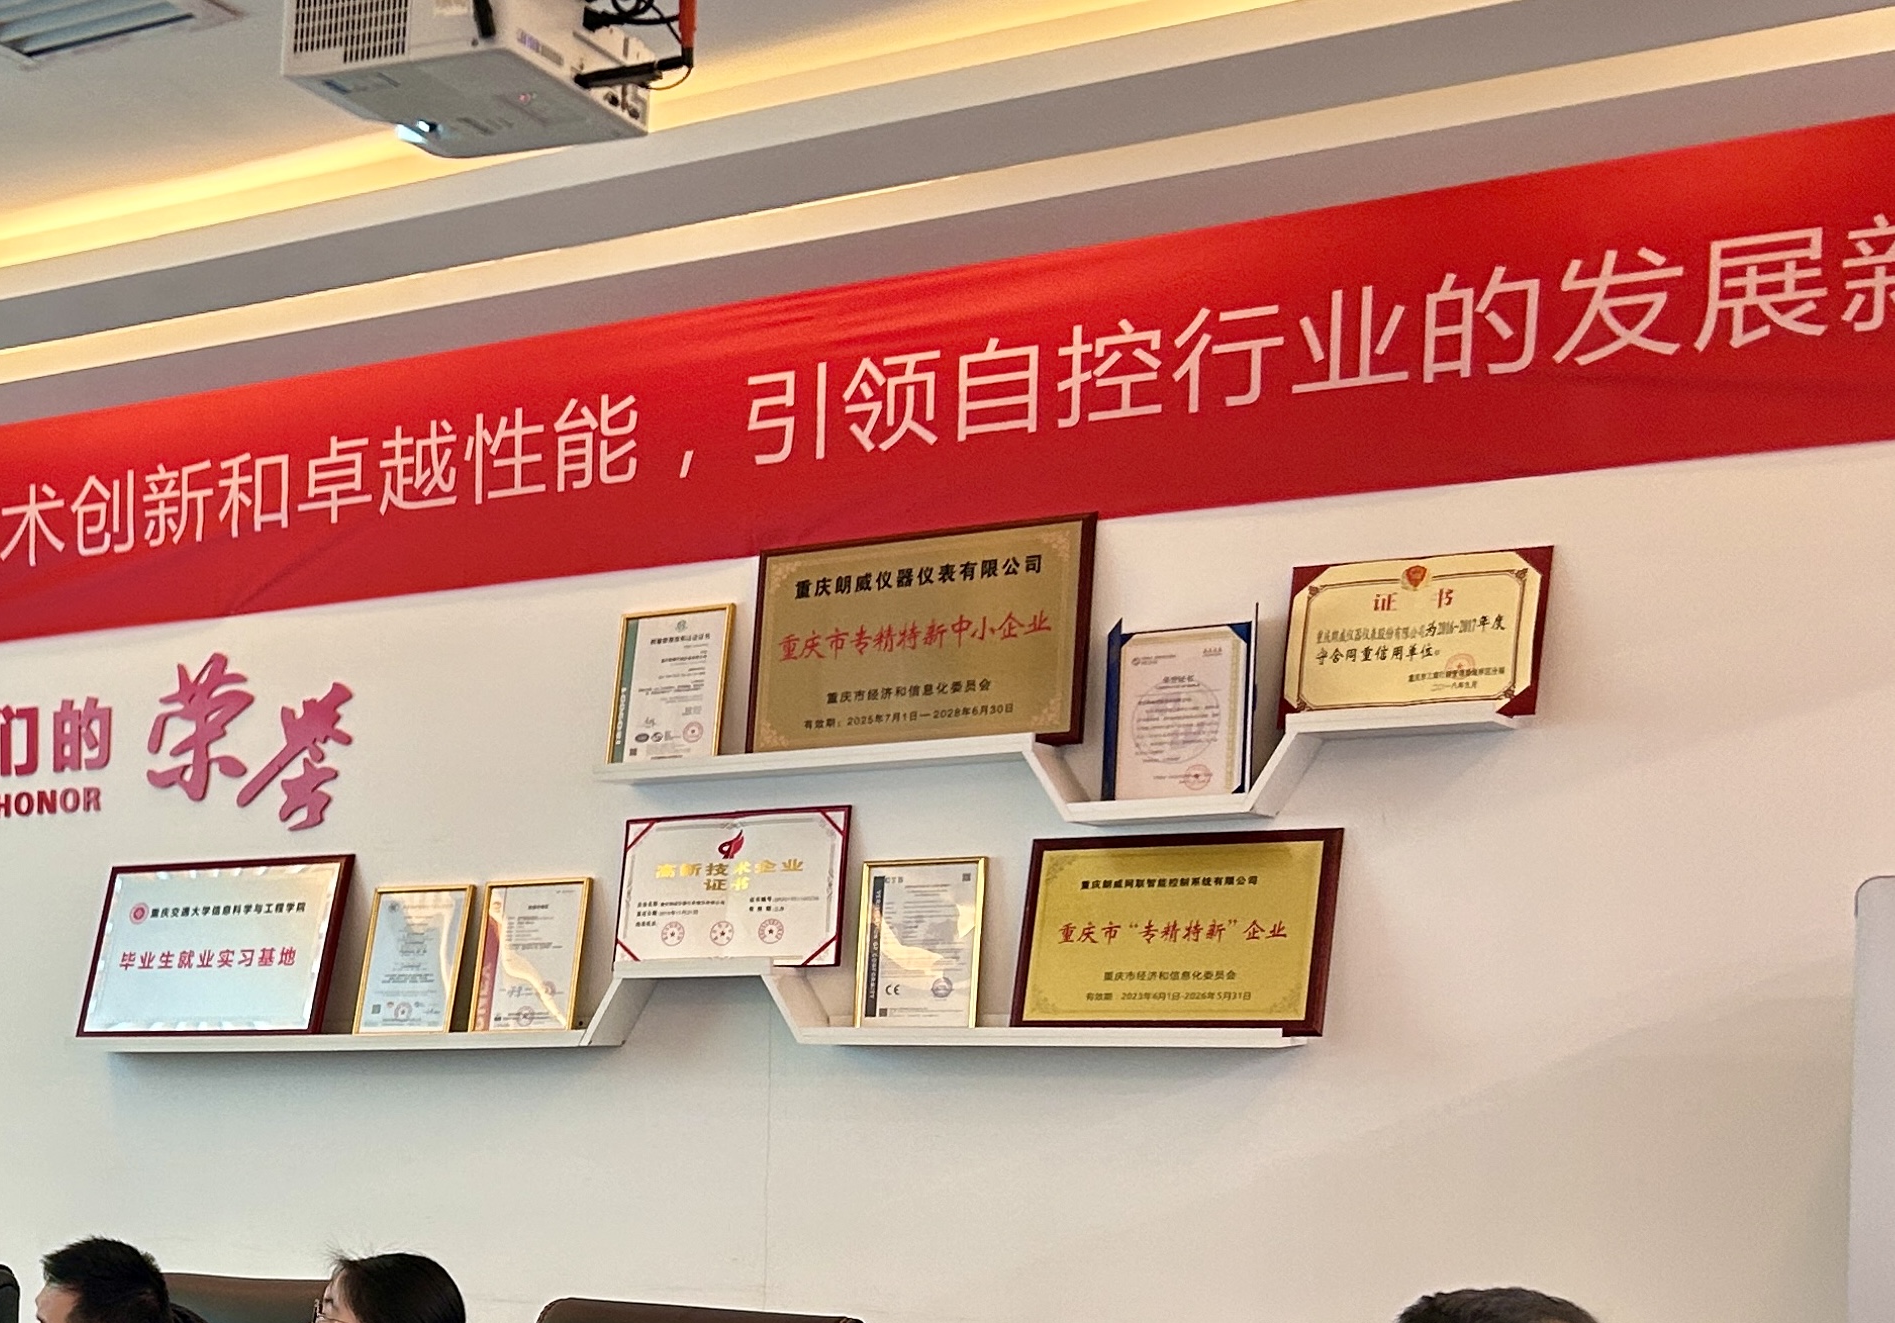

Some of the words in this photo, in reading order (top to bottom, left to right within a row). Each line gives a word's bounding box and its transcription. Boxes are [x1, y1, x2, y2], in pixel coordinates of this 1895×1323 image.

[795, 554, 1043, 600] 重庆朗威仪器仪表有限公司
[778, 610, 1051, 662] 重庆市专精特新中小企业
[826, 678, 992, 704] 重庆市经济和信息化委员会
[147, 652, 353, 831] 荣誉
[656, 858, 804, 879] 高新技术企业
[704, 876, 751, 891] 证书
[150, 901, 306, 919] 重庆交通大学信息科学与工程学院
[119, 946, 297, 971] 毕业生就业实习基地
